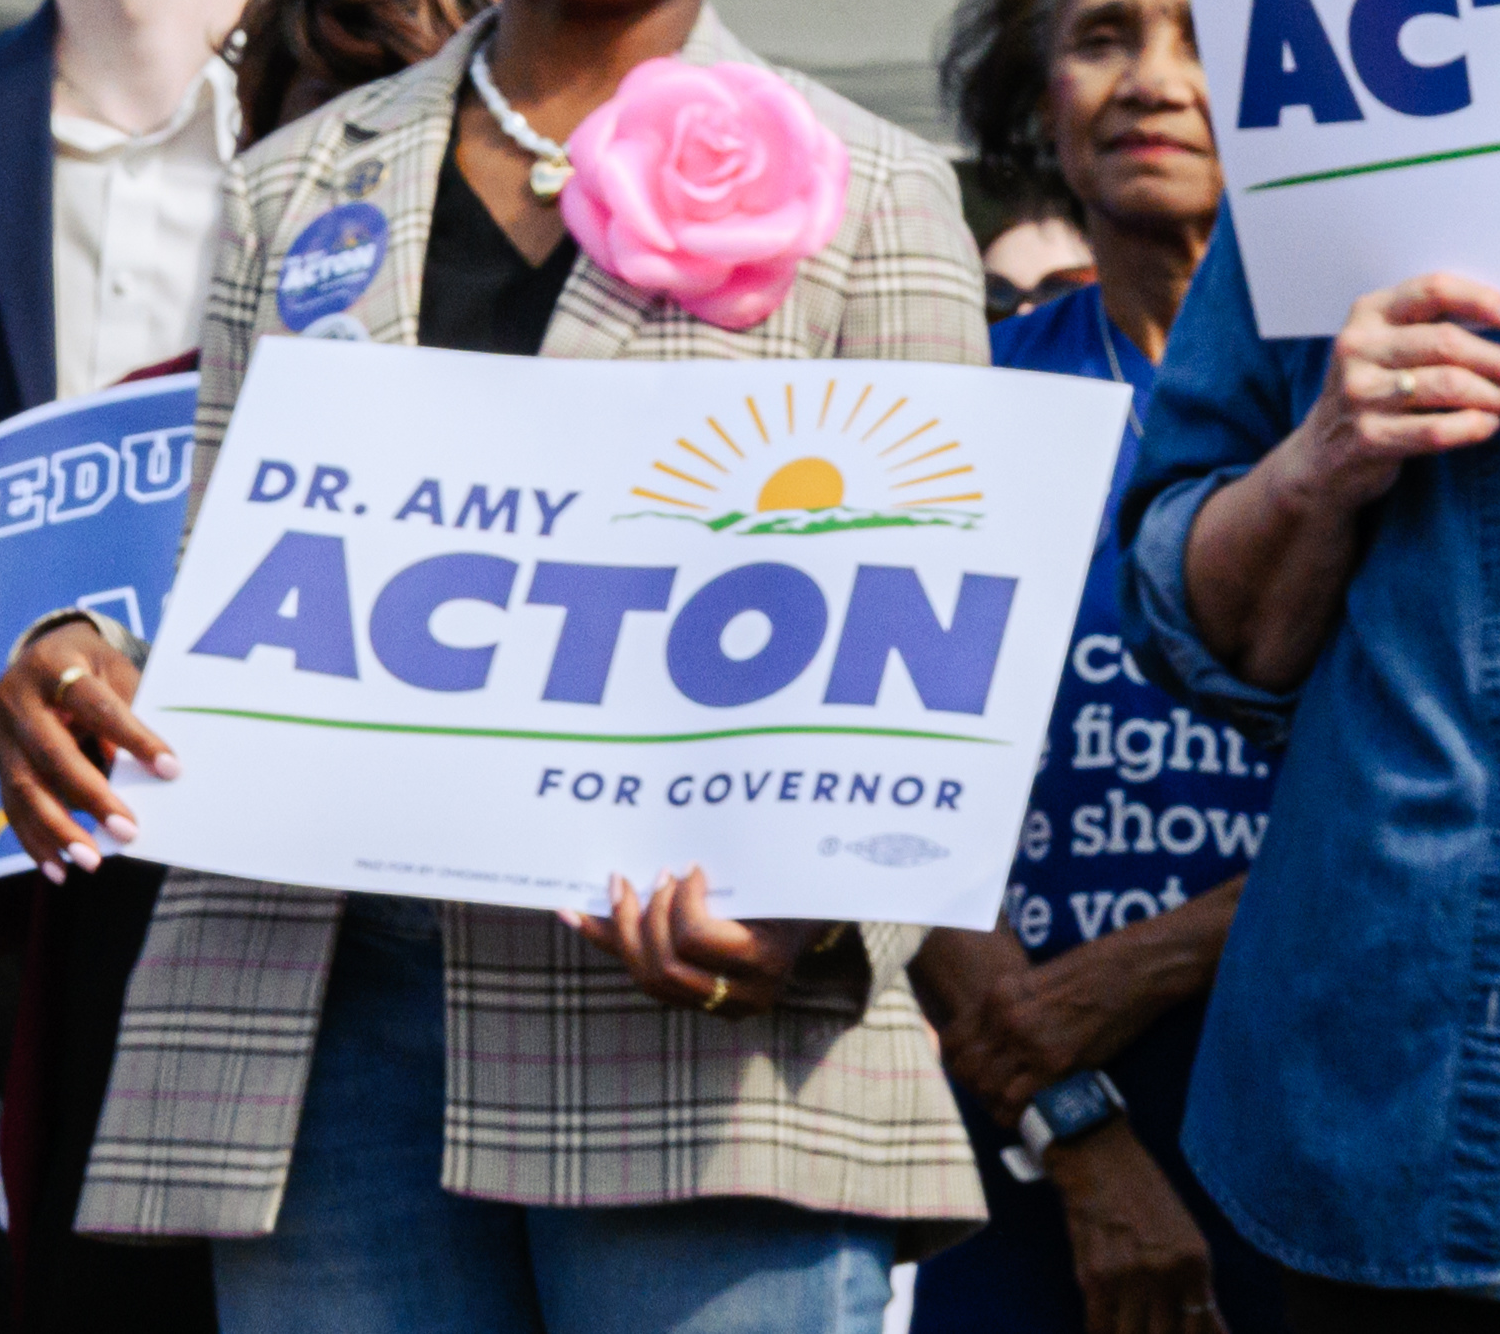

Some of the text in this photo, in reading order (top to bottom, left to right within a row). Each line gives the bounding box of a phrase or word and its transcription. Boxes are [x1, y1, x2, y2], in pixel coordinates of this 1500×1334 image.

[248, 460, 578, 535] DR. AMY
[189, 530, 1019, 716] ACTON
[538, 769, 963, 810] FOR GOVERNOR
[1071, 788, 1269, 859] show
